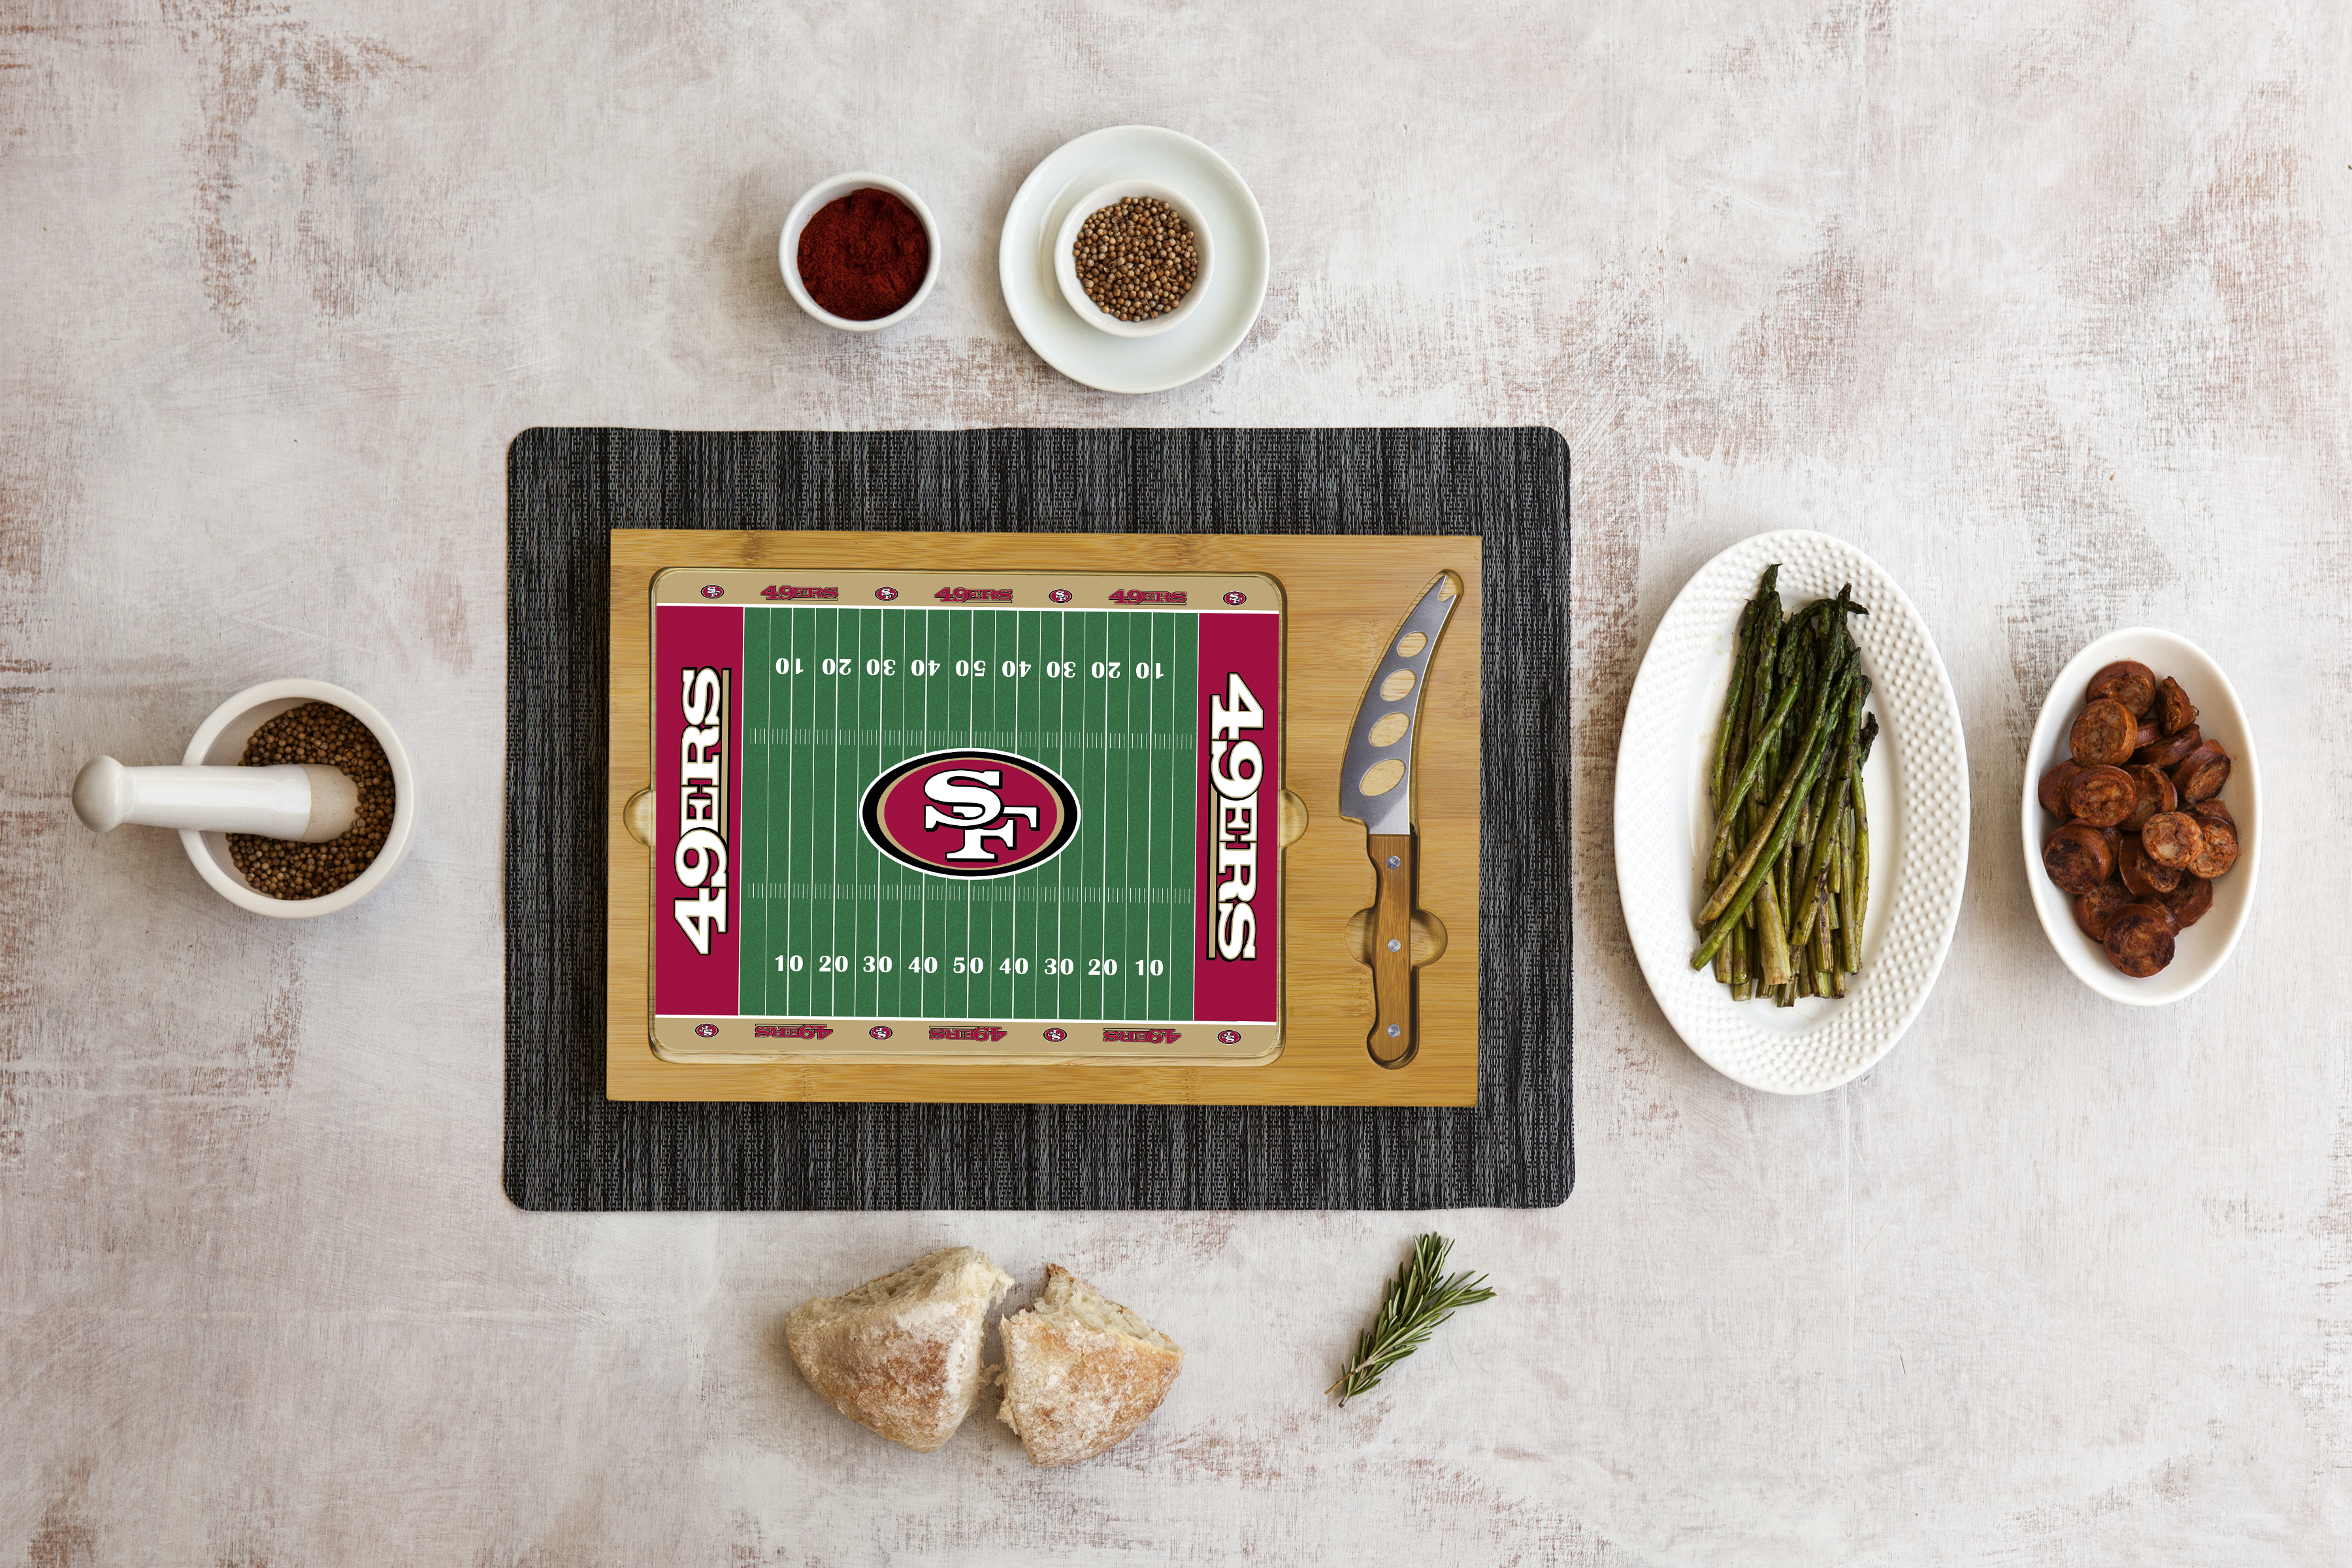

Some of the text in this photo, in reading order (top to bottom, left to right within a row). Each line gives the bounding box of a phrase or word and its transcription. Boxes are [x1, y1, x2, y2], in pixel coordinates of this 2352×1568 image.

[706, 586, 721, 597] SF
[760, 585, 838, 600] 49ERS
[881, 589, 896, 600] SF
[934, 587, 1013, 602] 49ERS
[1054, 591, 1070, 602] SF
[1109, 589, 1187, 604] 49ERS
[1229, 593, 1244, 604] SF
[775, 657, 1164, 679] 10 20 30 40 50 40 30 20 10
[673, 666, 729, 955] 49ERS
[923, 768, 1041, 862] SF
[1209, 672, 1265, 962] 49ERS
[775, 955, 1164, 976] 10 20 30 40 50 40 30 20 10
[698, 1024, 713, 1036] SF
[755, 1024, 833, 1039] 49ERS
[872, 1027, 887, 1038] SF
[929, 1026, 1007, 1042] 49ERS
[1046, 1029, 1061, 1040] SF
[1103, 1028, 1182, 1044] 49ERS
[1220, 1031, 1235, 1043] SF
